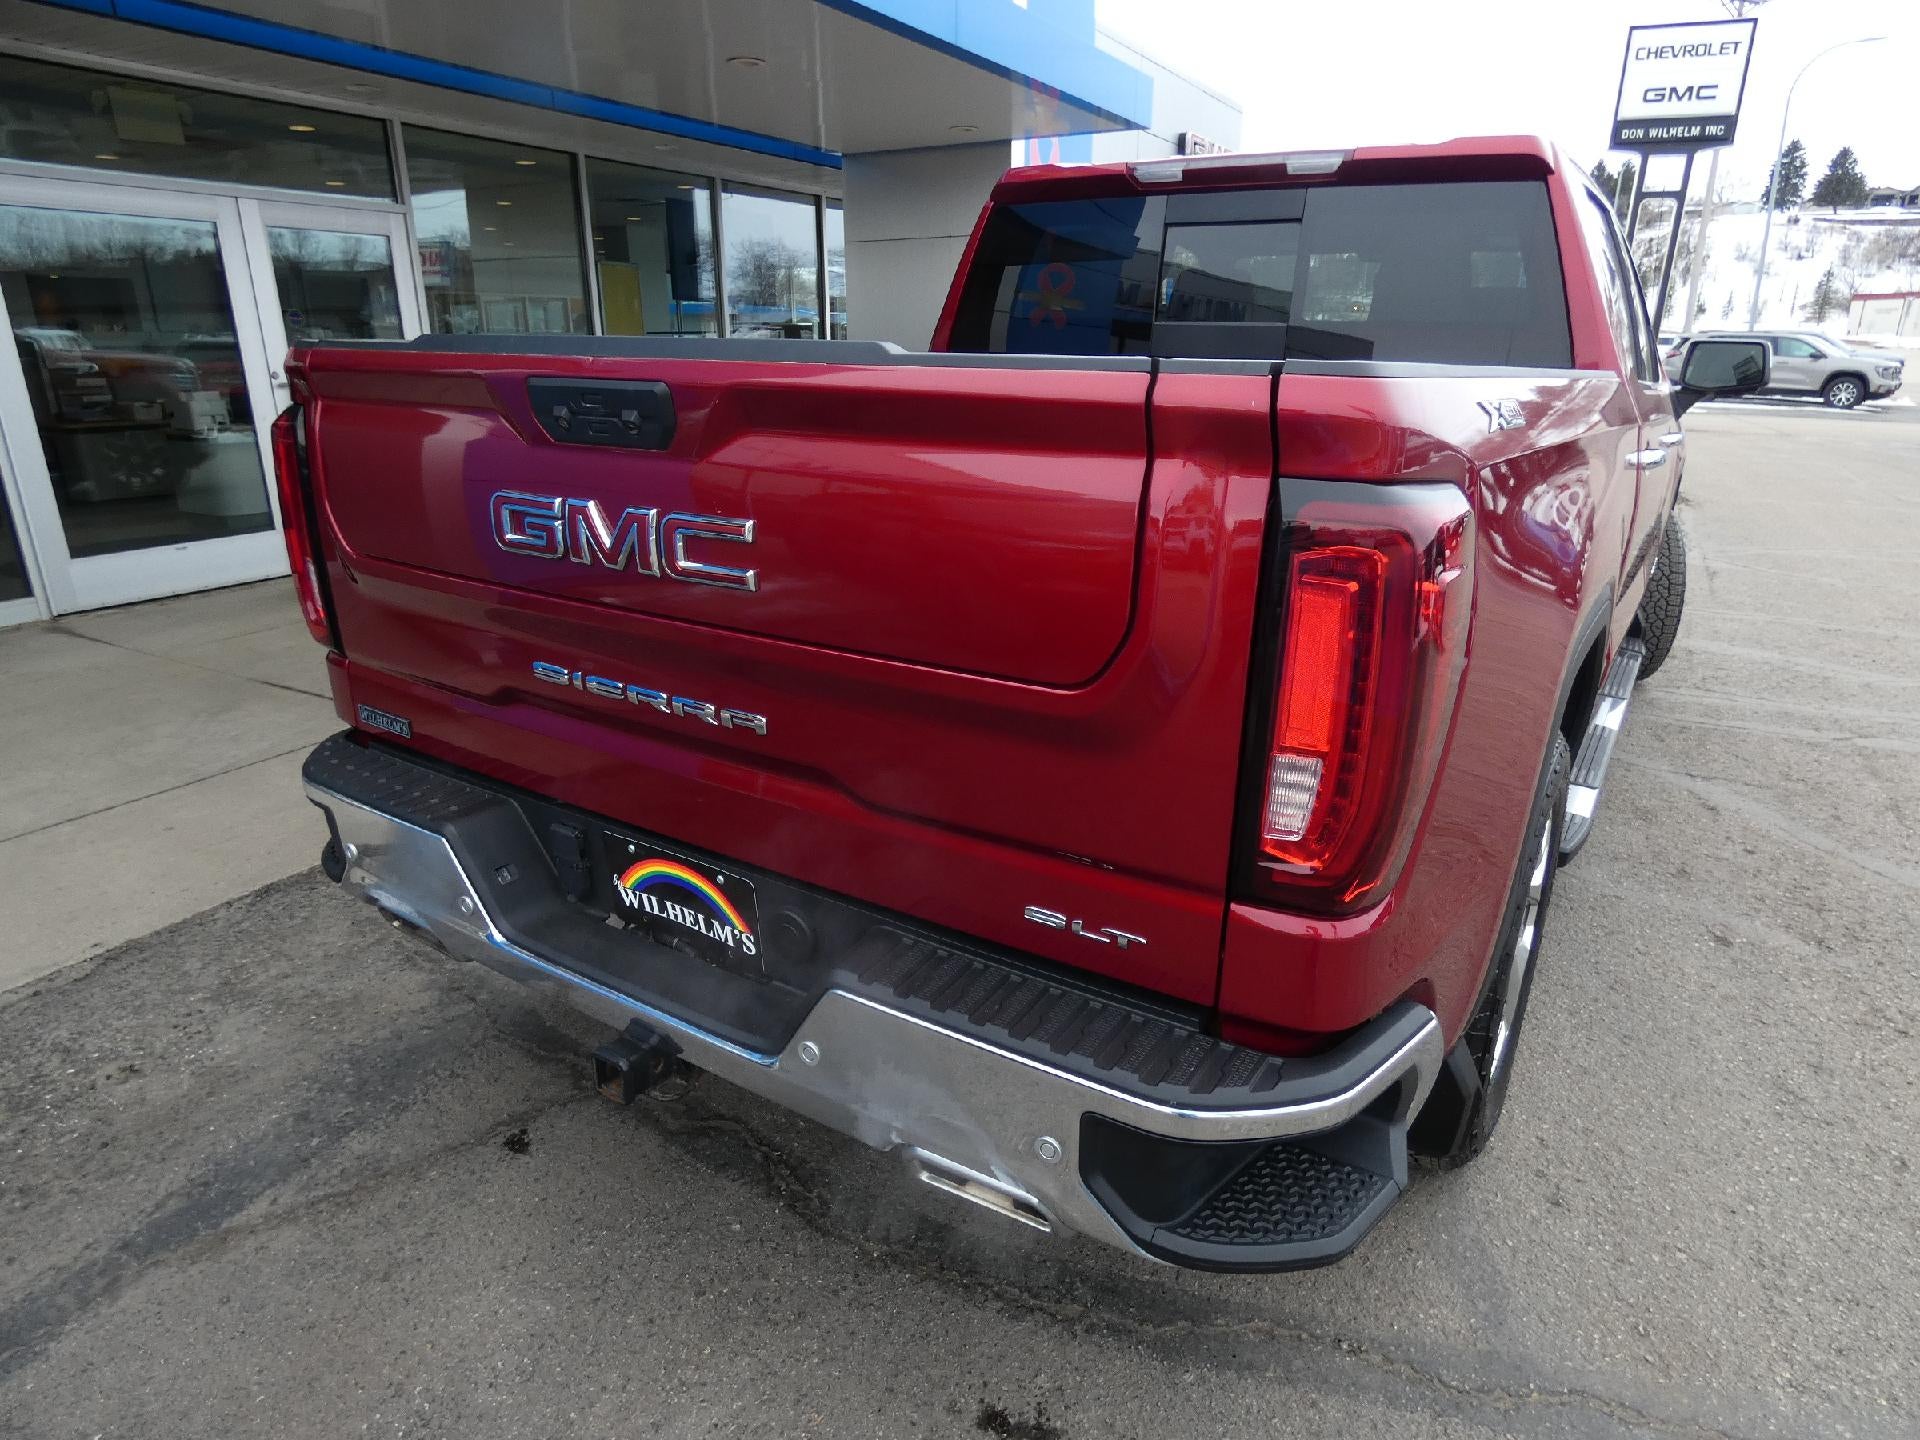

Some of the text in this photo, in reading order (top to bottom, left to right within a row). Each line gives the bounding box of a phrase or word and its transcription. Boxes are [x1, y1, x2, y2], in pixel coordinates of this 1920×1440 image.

[1635, 41, 1742, 61] CHEVROLET
[1642, 84, 1718, 103] GMC
[1621, 124, 1725, 140] DON WILHELM INC
[489, 489, 759, 592] GMC
[532, 660, 767, 736] SIERRA
[360, 708, 409, 736] WILHELM'S
[618, 884, 757, 956] WILHELM'S
[1024, 905, 1147, 950] SLT
